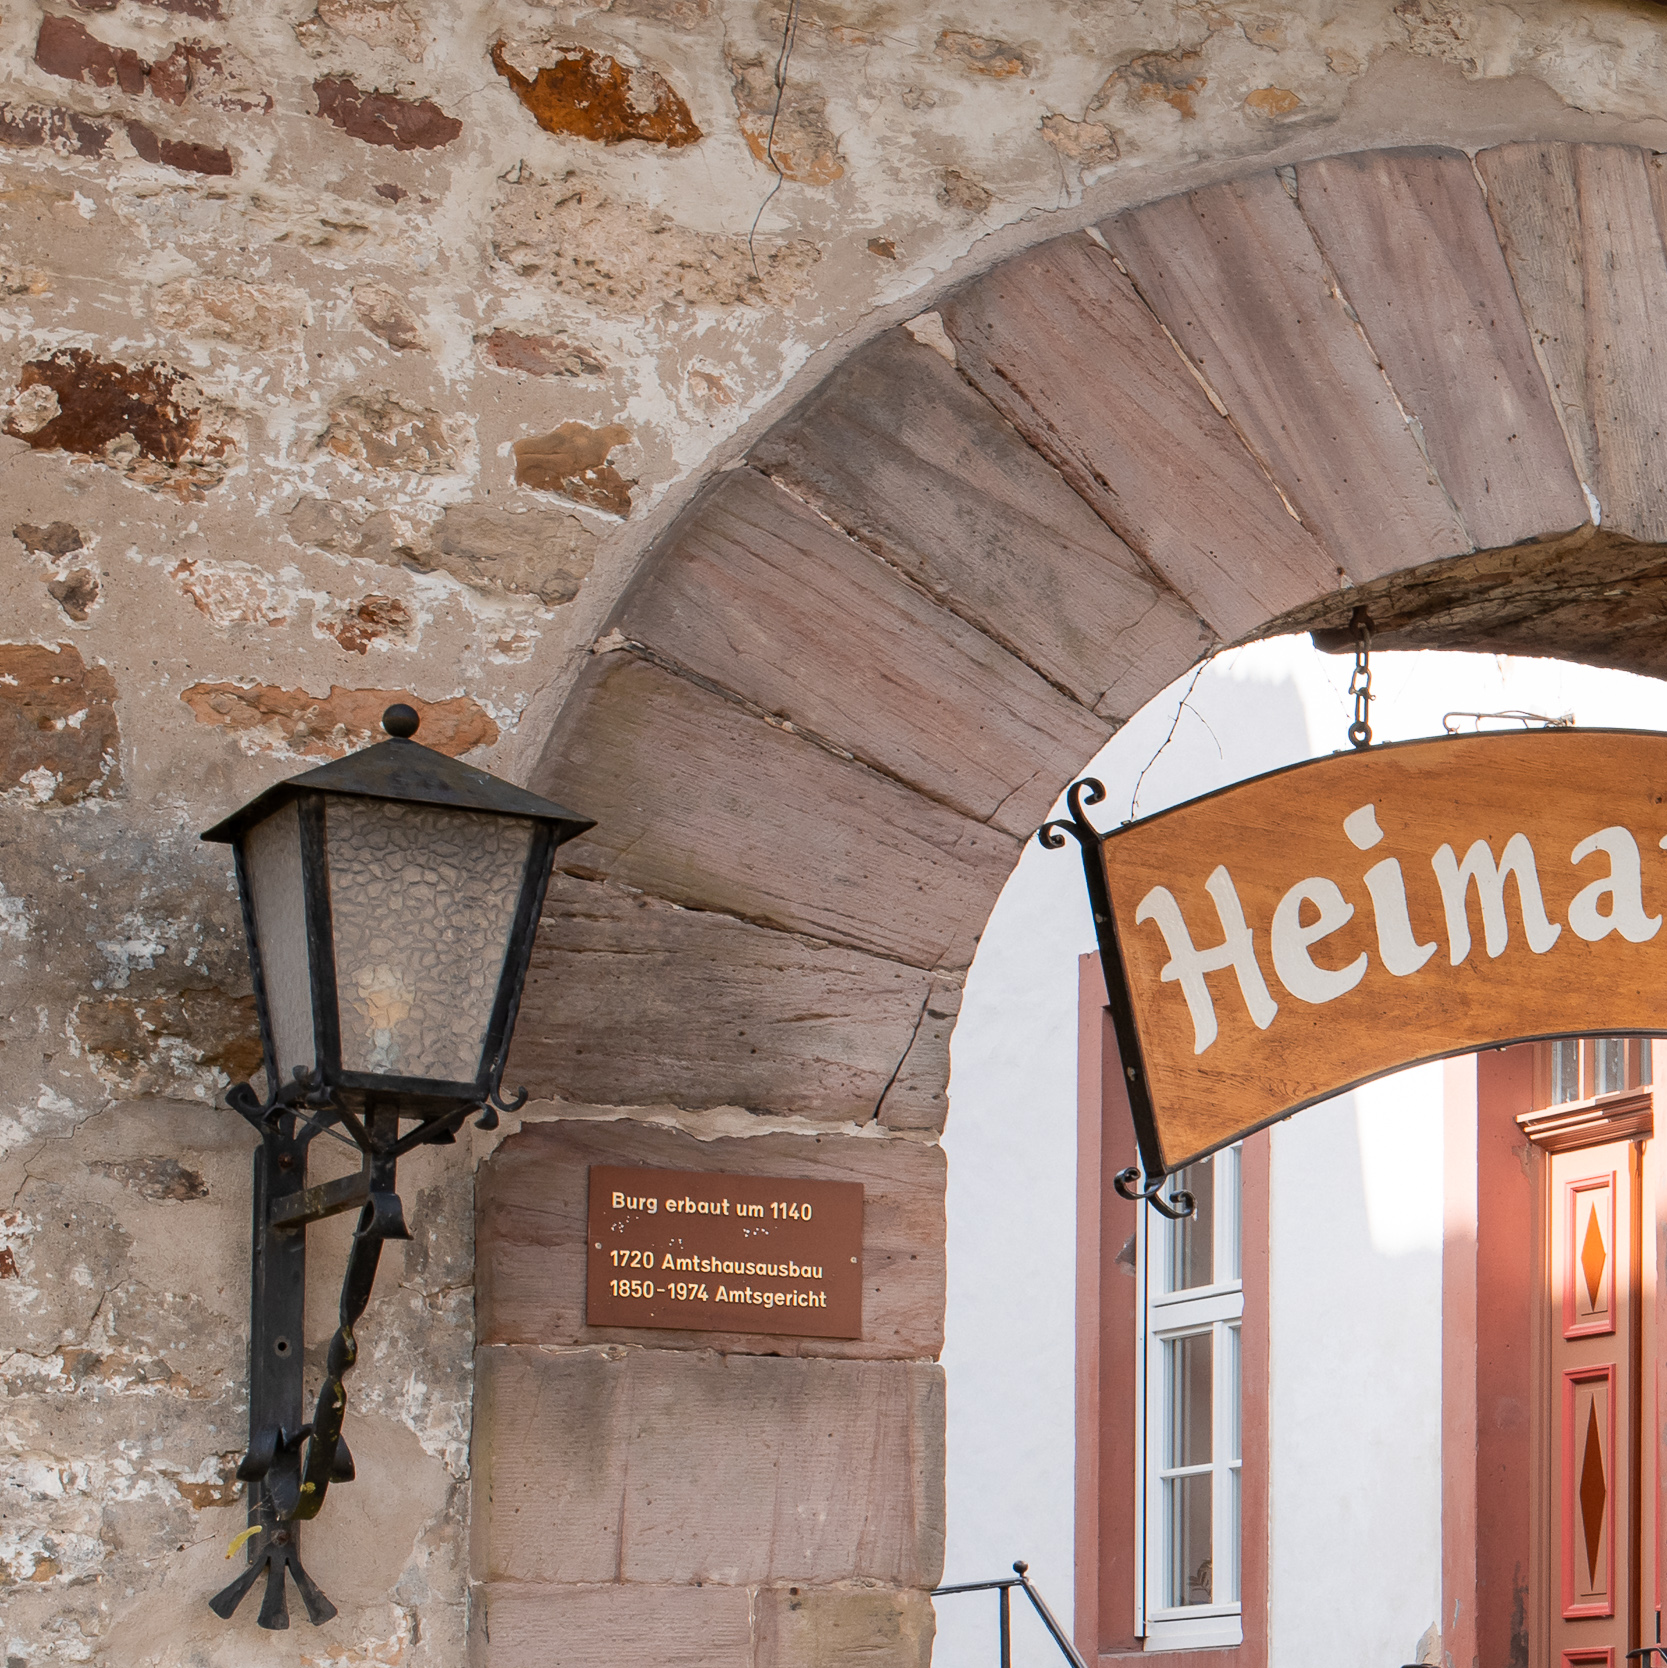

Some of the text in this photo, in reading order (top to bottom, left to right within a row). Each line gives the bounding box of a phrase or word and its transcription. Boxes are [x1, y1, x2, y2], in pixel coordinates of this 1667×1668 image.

[612, 1191, 813, 1221] Burg erbaut um 1140
[610, 1250, 823, 1279] 1720 Amtshausausbau
[715, 1285, 827, 1308] Amtsgericht
